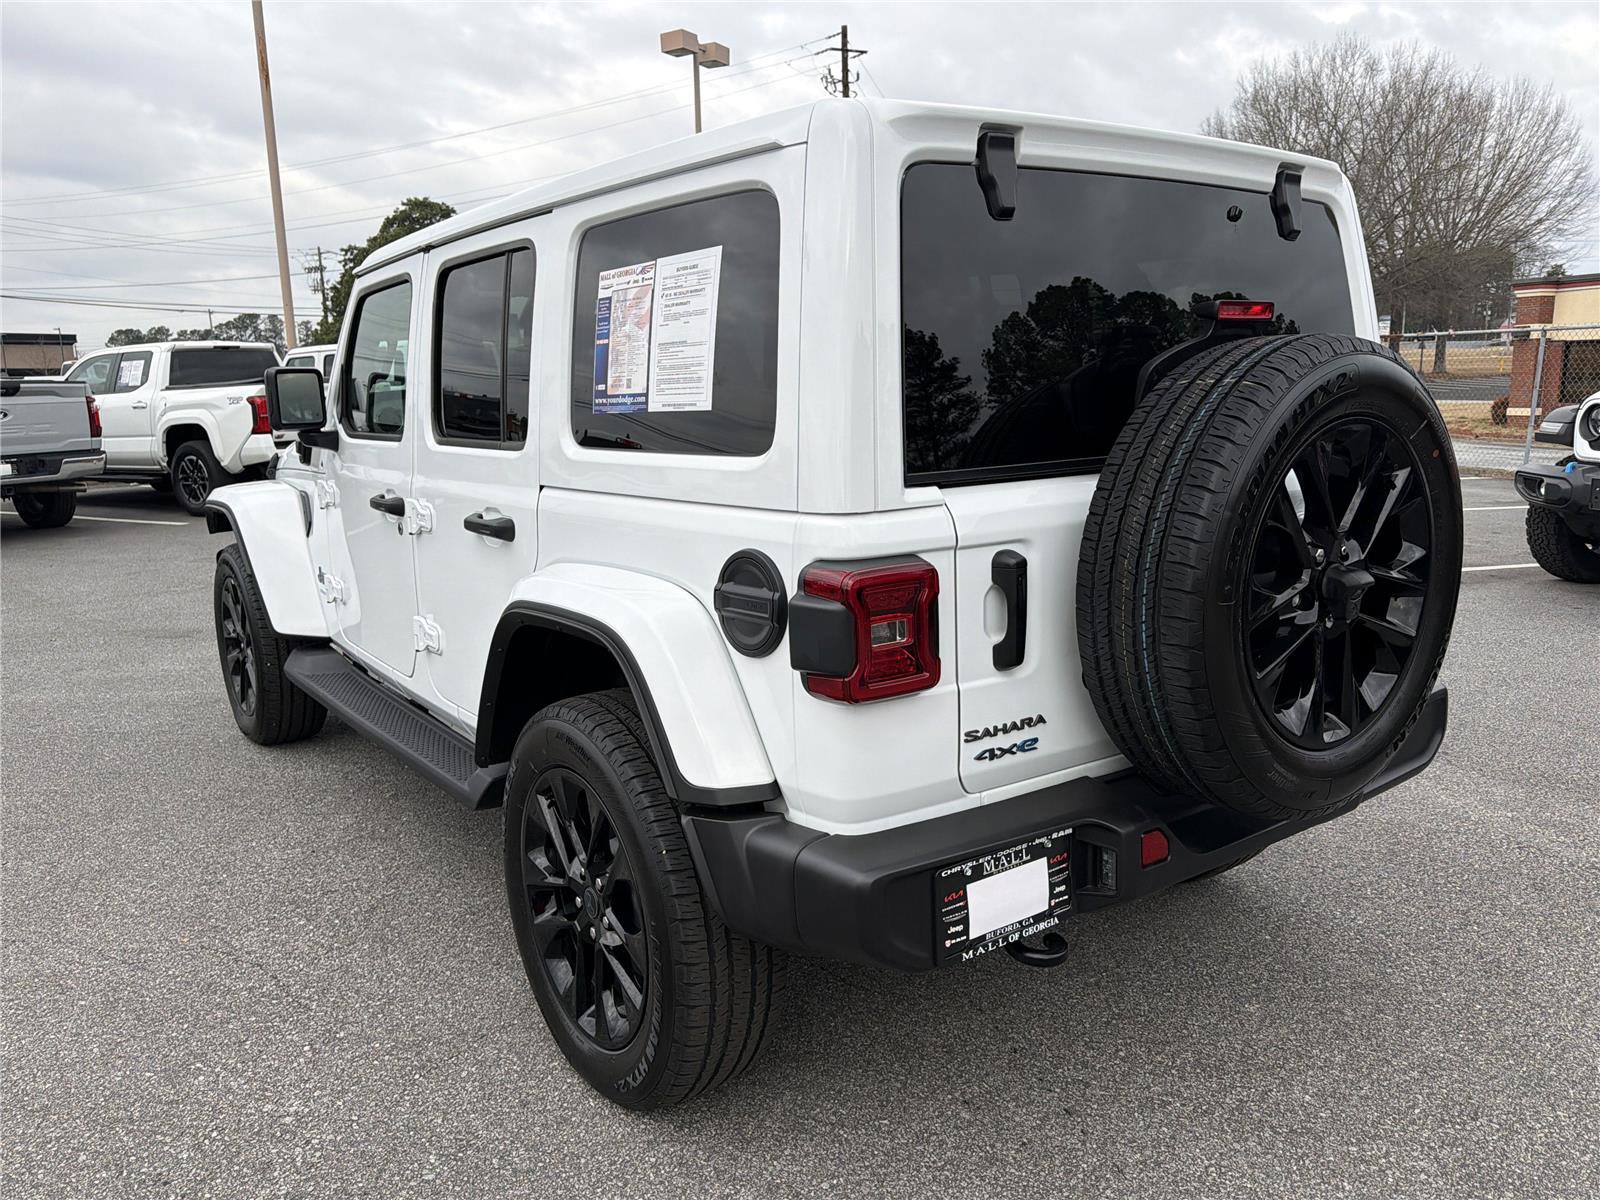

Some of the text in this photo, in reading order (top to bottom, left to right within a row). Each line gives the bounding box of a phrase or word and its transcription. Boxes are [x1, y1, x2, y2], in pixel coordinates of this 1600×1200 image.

[595, 395, 646, 406] www.yourdodge.com
[963, 713, 1047, 743] SAHARA
[941, 827, 1073, 877] CHRYSLER DODGE Jeep RAM
[947, 924, 964, 934] Jeep
[1008, 931, 1021, 943] OF
[1022, 916, 1059, 937] GEORGIA
[1022, 917, 1034, 927] GA
